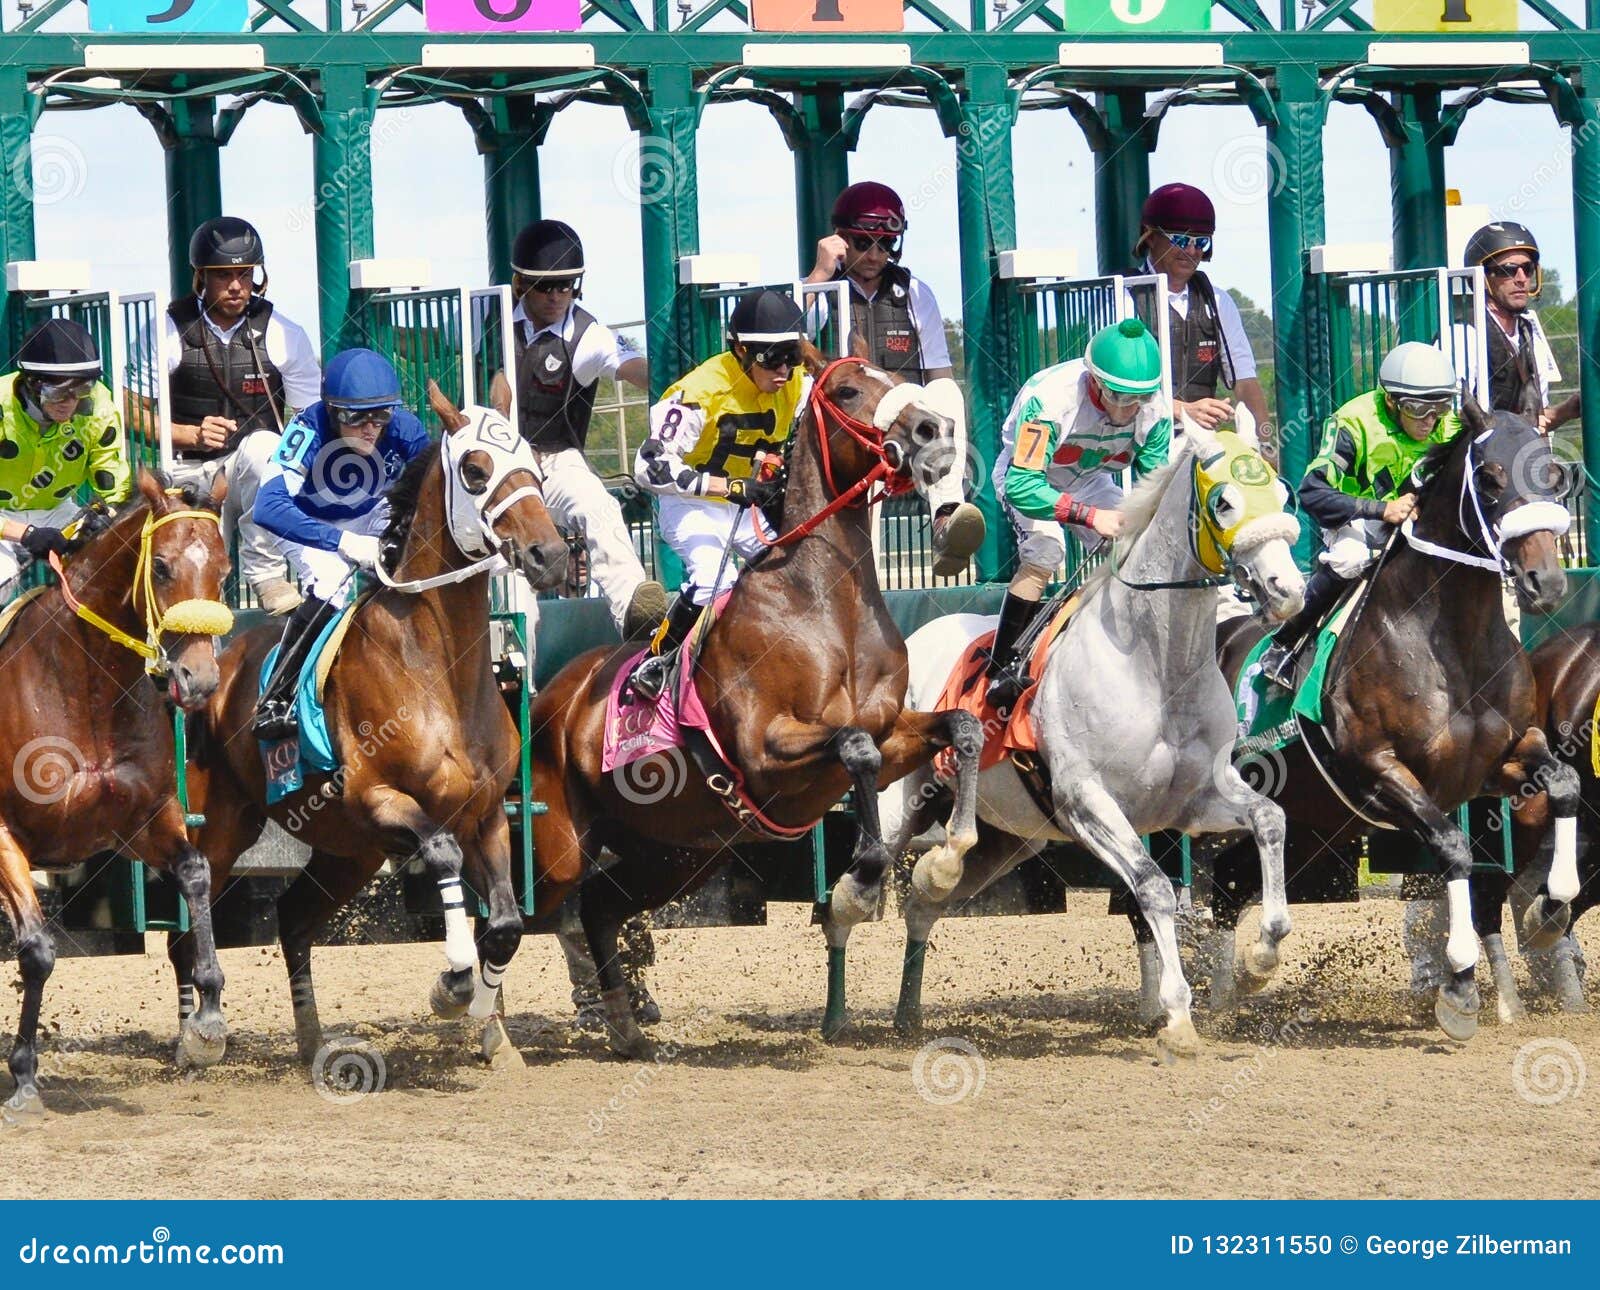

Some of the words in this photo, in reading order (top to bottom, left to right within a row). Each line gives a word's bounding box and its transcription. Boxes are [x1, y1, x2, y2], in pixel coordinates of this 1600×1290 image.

[487, 422, 511, 441] G
[659, 408, 682, 442] 8
[279, 429, 306, 461] 9
[1024, 427, 1042, 463] 7
